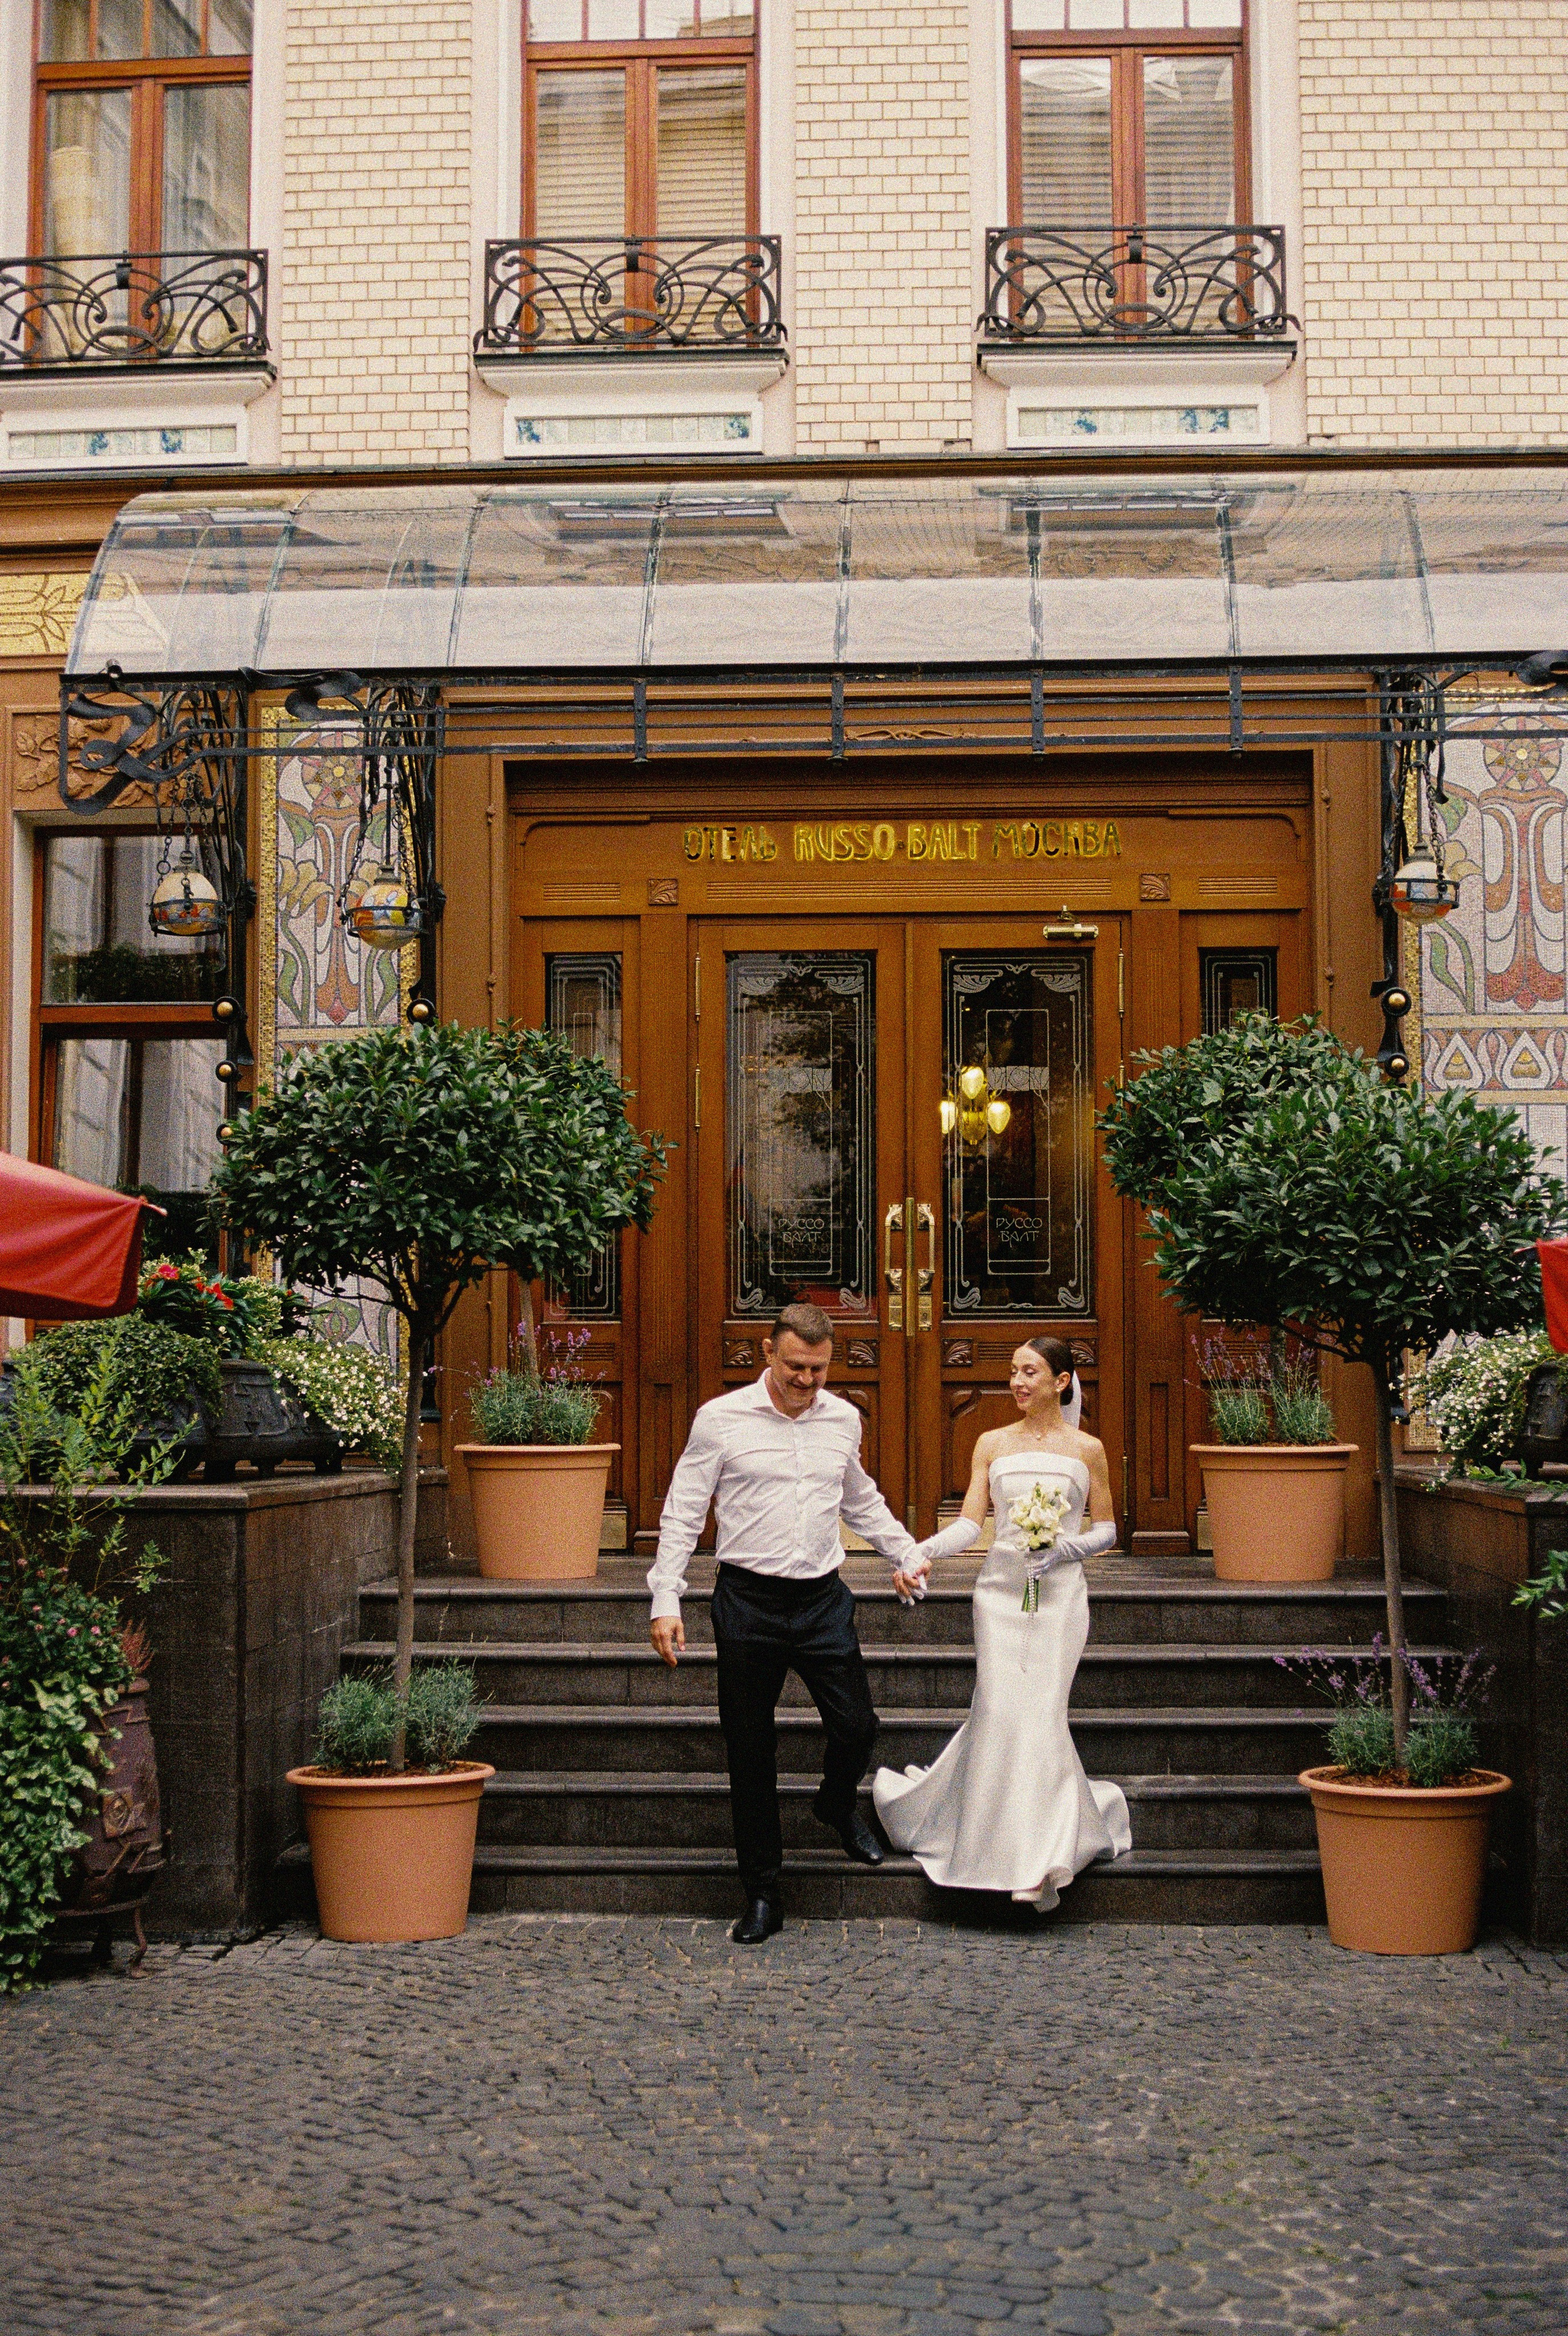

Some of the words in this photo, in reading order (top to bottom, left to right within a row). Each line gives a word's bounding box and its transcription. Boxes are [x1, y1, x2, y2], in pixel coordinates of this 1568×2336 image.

[684, 826, 777, 861] ОТЕЛЬ
[794, 824, 895, 861] RUSSO
[908, 823, 981, 861] BALT
[991, 821, 1121, 858] МОСКВА
[996, 1218, 1042, 1230] РУССО
